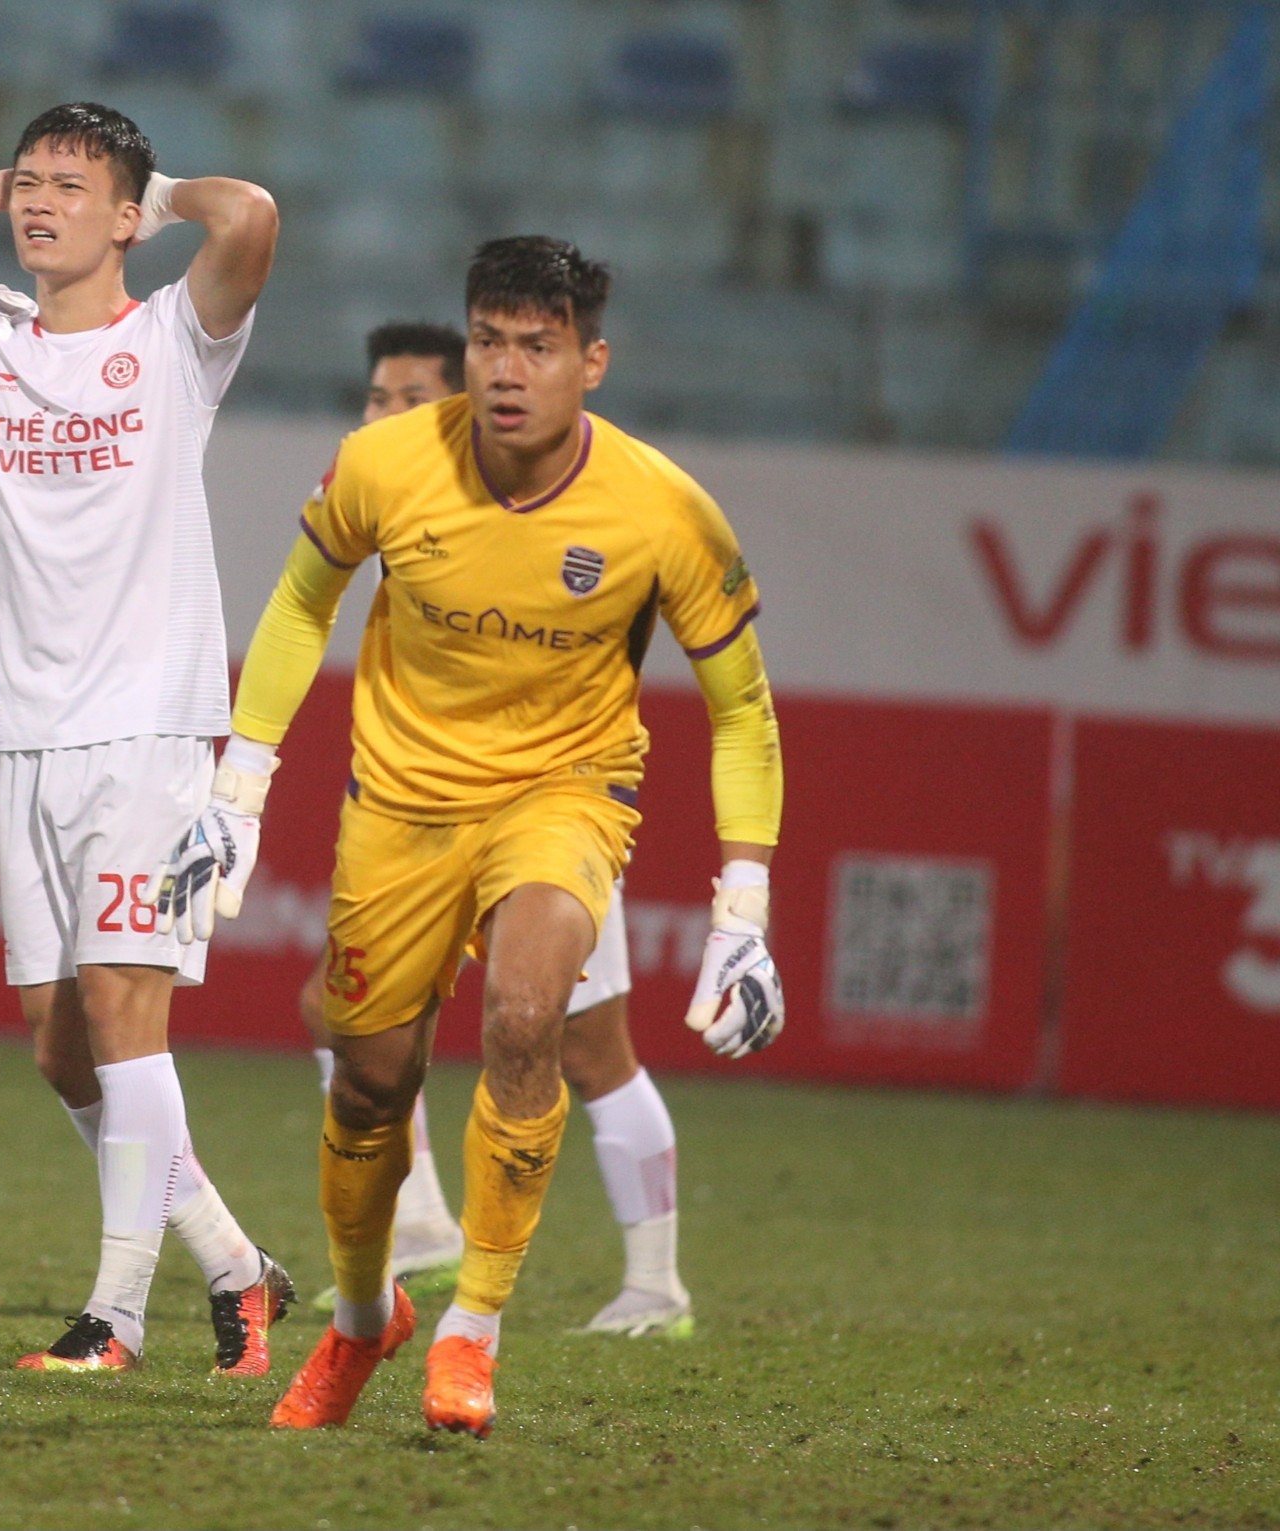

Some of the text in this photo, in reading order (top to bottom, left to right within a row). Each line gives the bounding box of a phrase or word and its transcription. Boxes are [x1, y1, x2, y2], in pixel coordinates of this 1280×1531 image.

[53, 408, 143, 444] CÔNG
[416, 597, 609, 650] ECAMEX
[97, 873, 156, 933] 28
[325, 932, 368, 1003] 25
